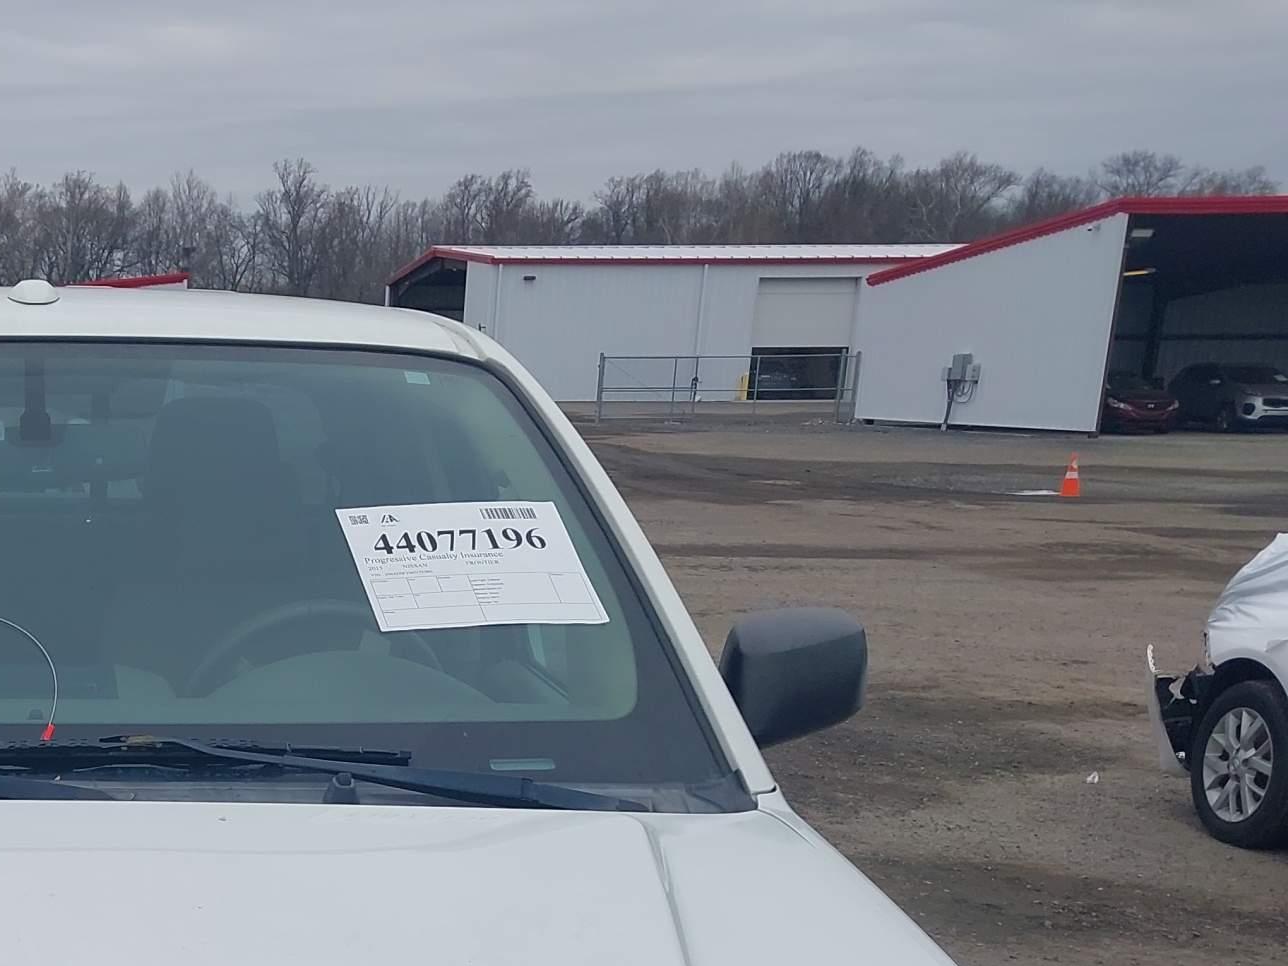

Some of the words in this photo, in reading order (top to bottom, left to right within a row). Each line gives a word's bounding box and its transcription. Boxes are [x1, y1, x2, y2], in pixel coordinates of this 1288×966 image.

[374, 527, 547, 554] 44077196
[365, 555, 417, 566] Progressive
[419, 552, 458, 561] Casualty
[460, 551, 504, 559] Insurance
